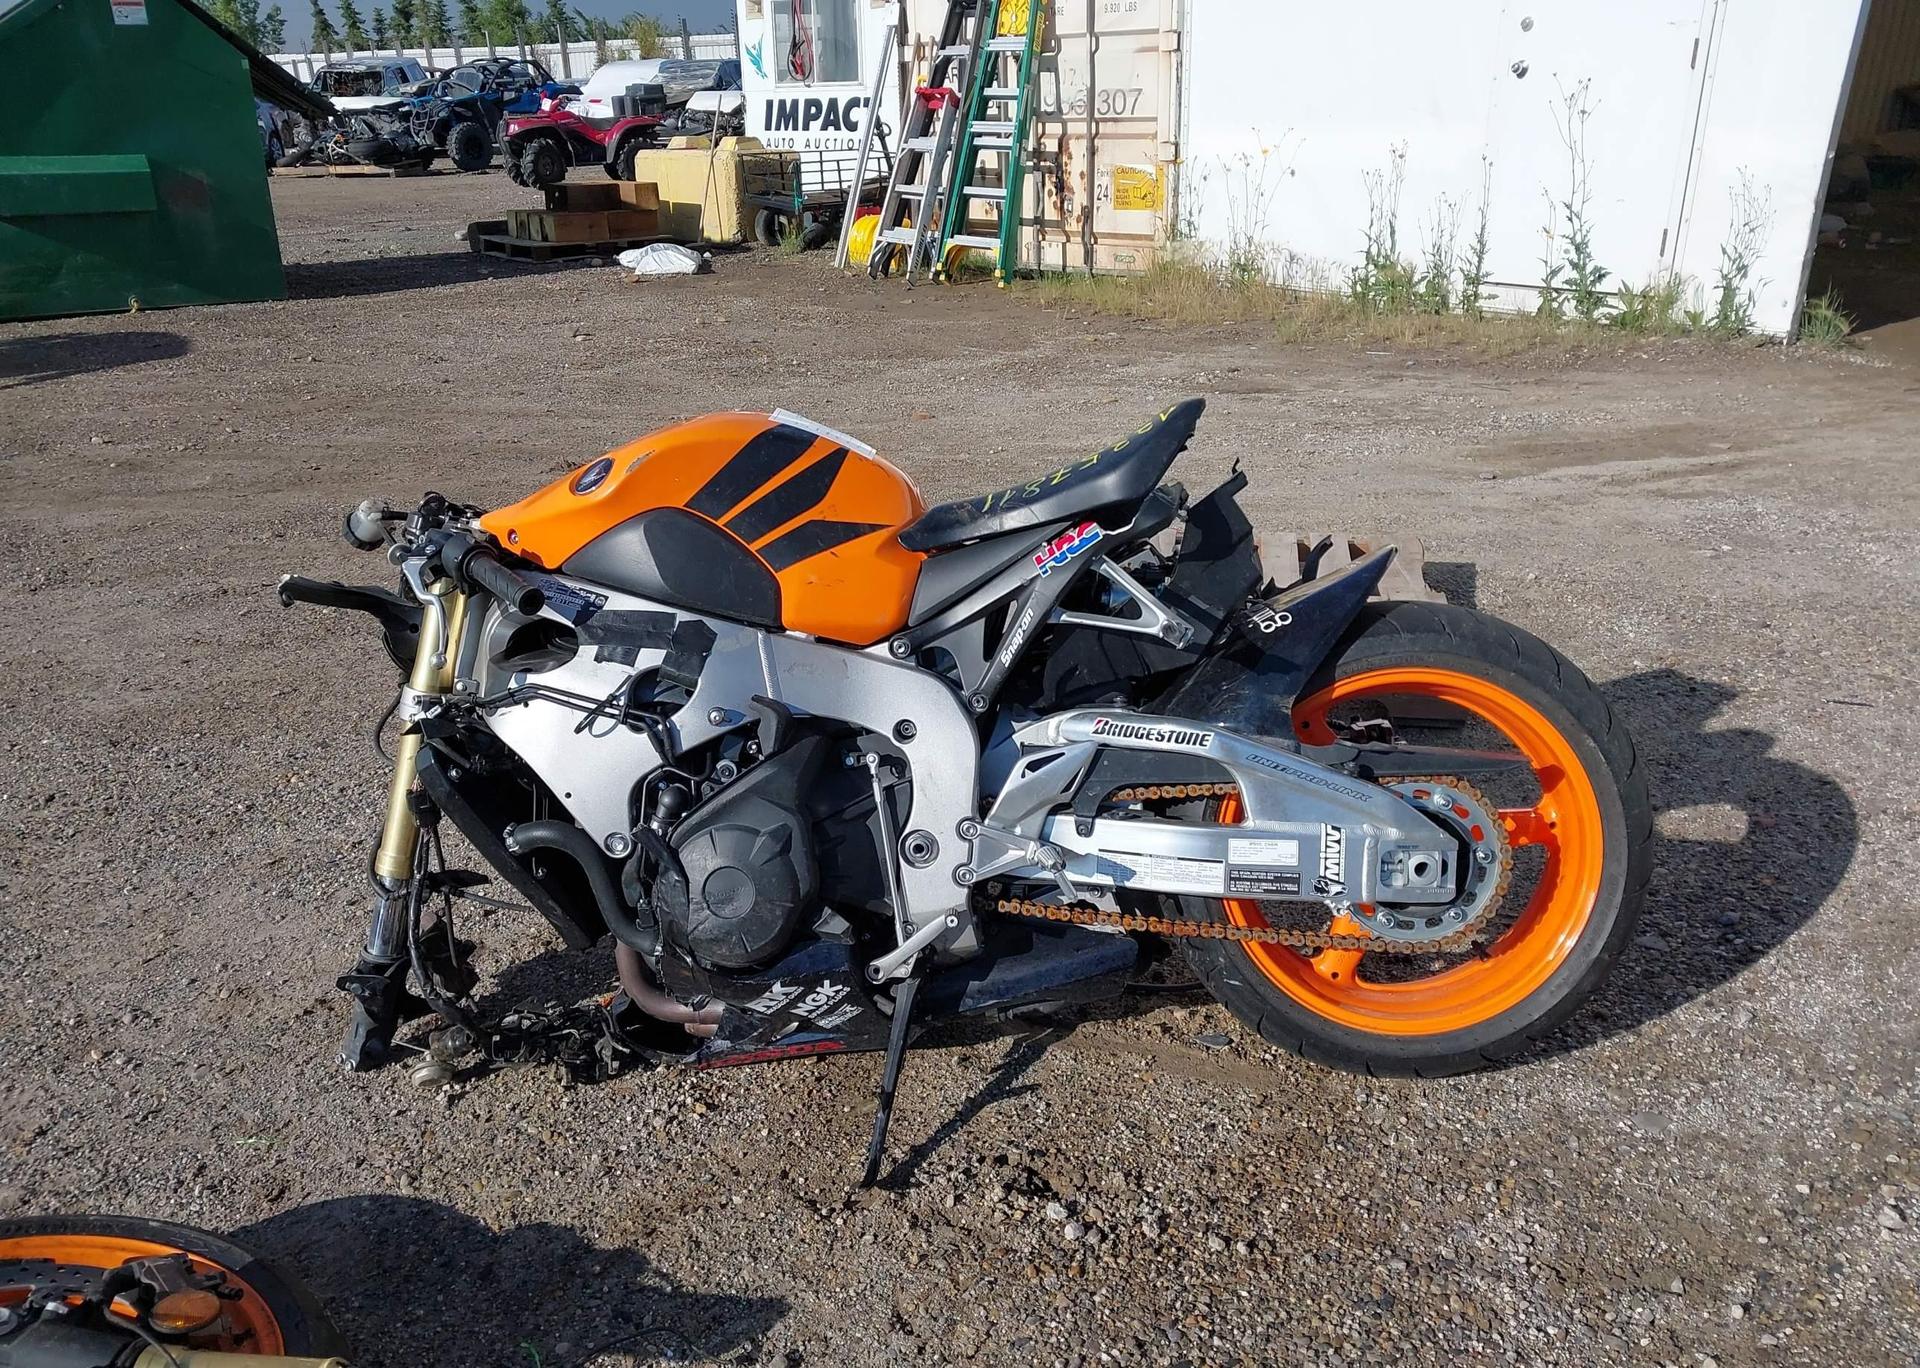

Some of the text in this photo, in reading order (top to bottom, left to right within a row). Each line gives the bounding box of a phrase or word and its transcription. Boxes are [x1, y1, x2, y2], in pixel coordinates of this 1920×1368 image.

[1124, 1, 1137, 12] LBS
[766, 137, 795, 149] AUTO
[1032, 520, 1103, 578] HRC
[1001, 607, 1034, 668] Snap-on
[1091, 718, 1212, 747] BRIDGESTONE
[1246, 753, 1290, 772] UNIT
[744, 979, 800, 1013] RK
[789, 979, 844, 1017] NGK
[807, 1004, 831, 1019] SPARK
[828, 985, 851, 1006] PLUGS
